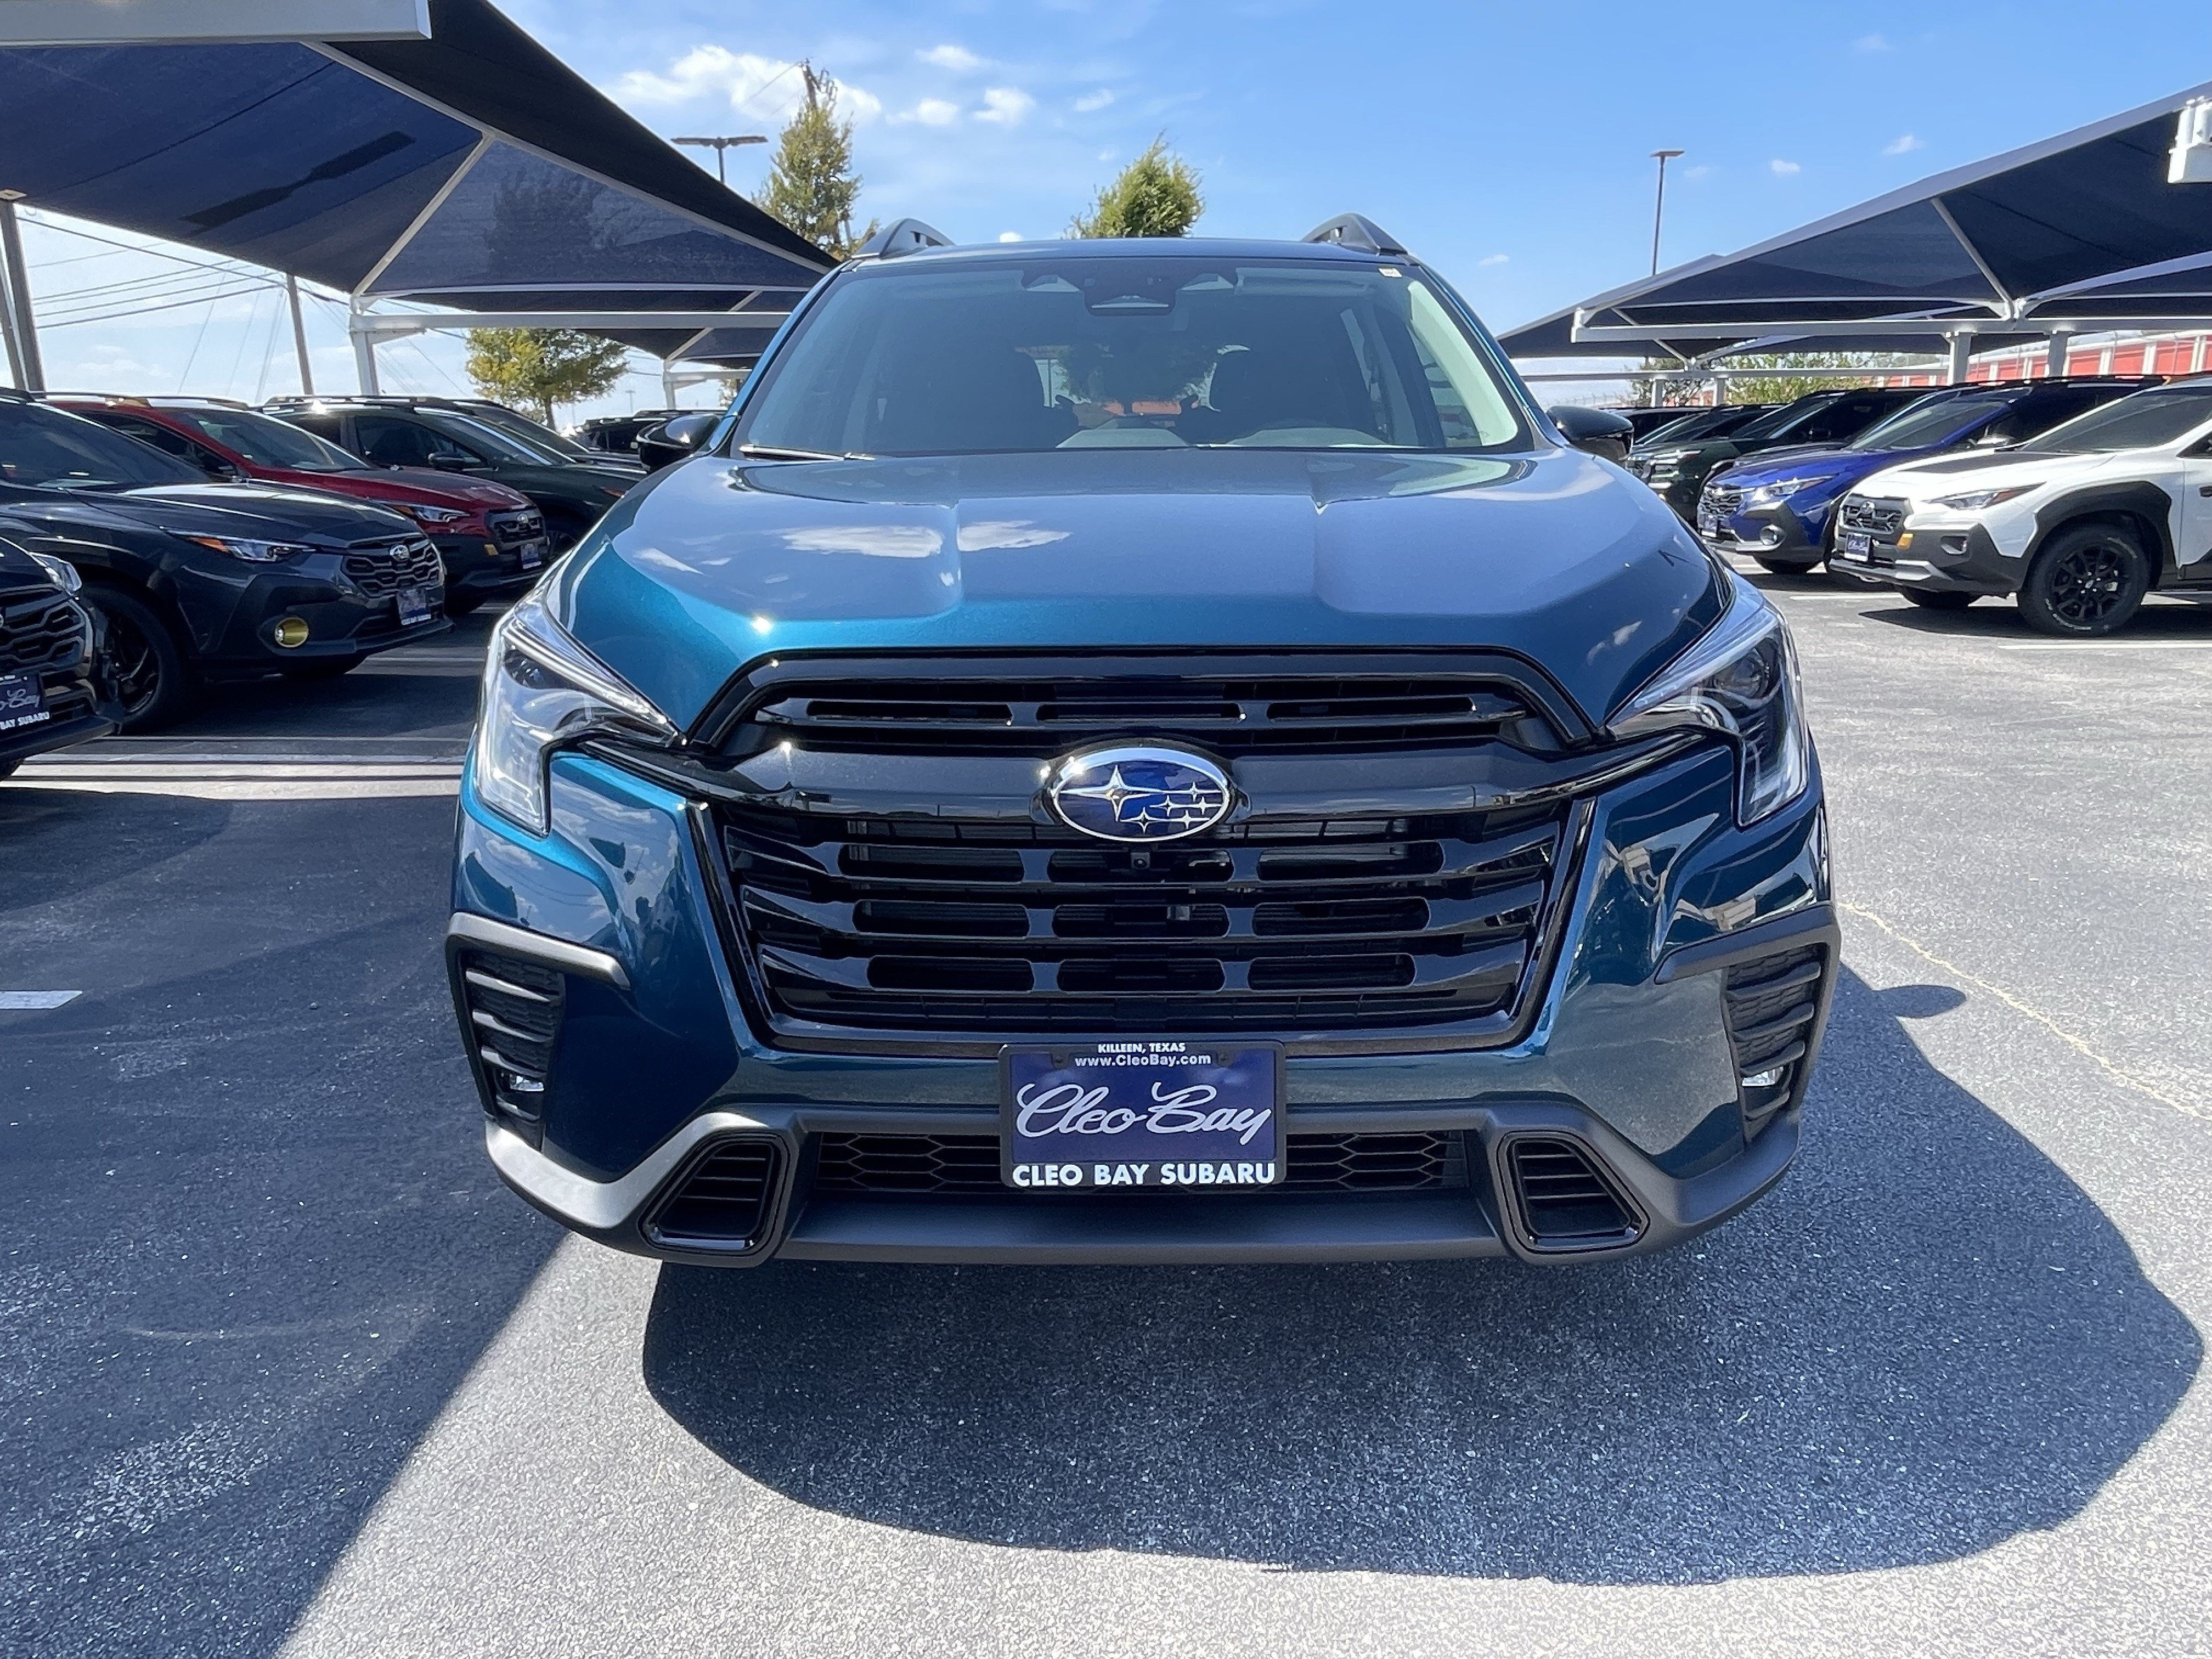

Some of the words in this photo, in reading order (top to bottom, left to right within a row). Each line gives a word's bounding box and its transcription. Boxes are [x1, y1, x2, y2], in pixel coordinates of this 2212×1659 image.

[18, 711, 50, 726] SUBARU
[1098, 1043, 1146, 1053] KILLEEN,
[1149, 1042, 1186, 1052] TEXAS
[1075, 1054, 1211, 1067] www.CleoBay.com
[1016, 1083, 1147, 1138] Cleo
[1146, 1082, 1272, 1145] Bay
[1013, 1165, 1083, 1187] CLEO
[1094, 1164, 1149, 1185] BAY
[1160, 1163, 1275, 1184] SUBARU
